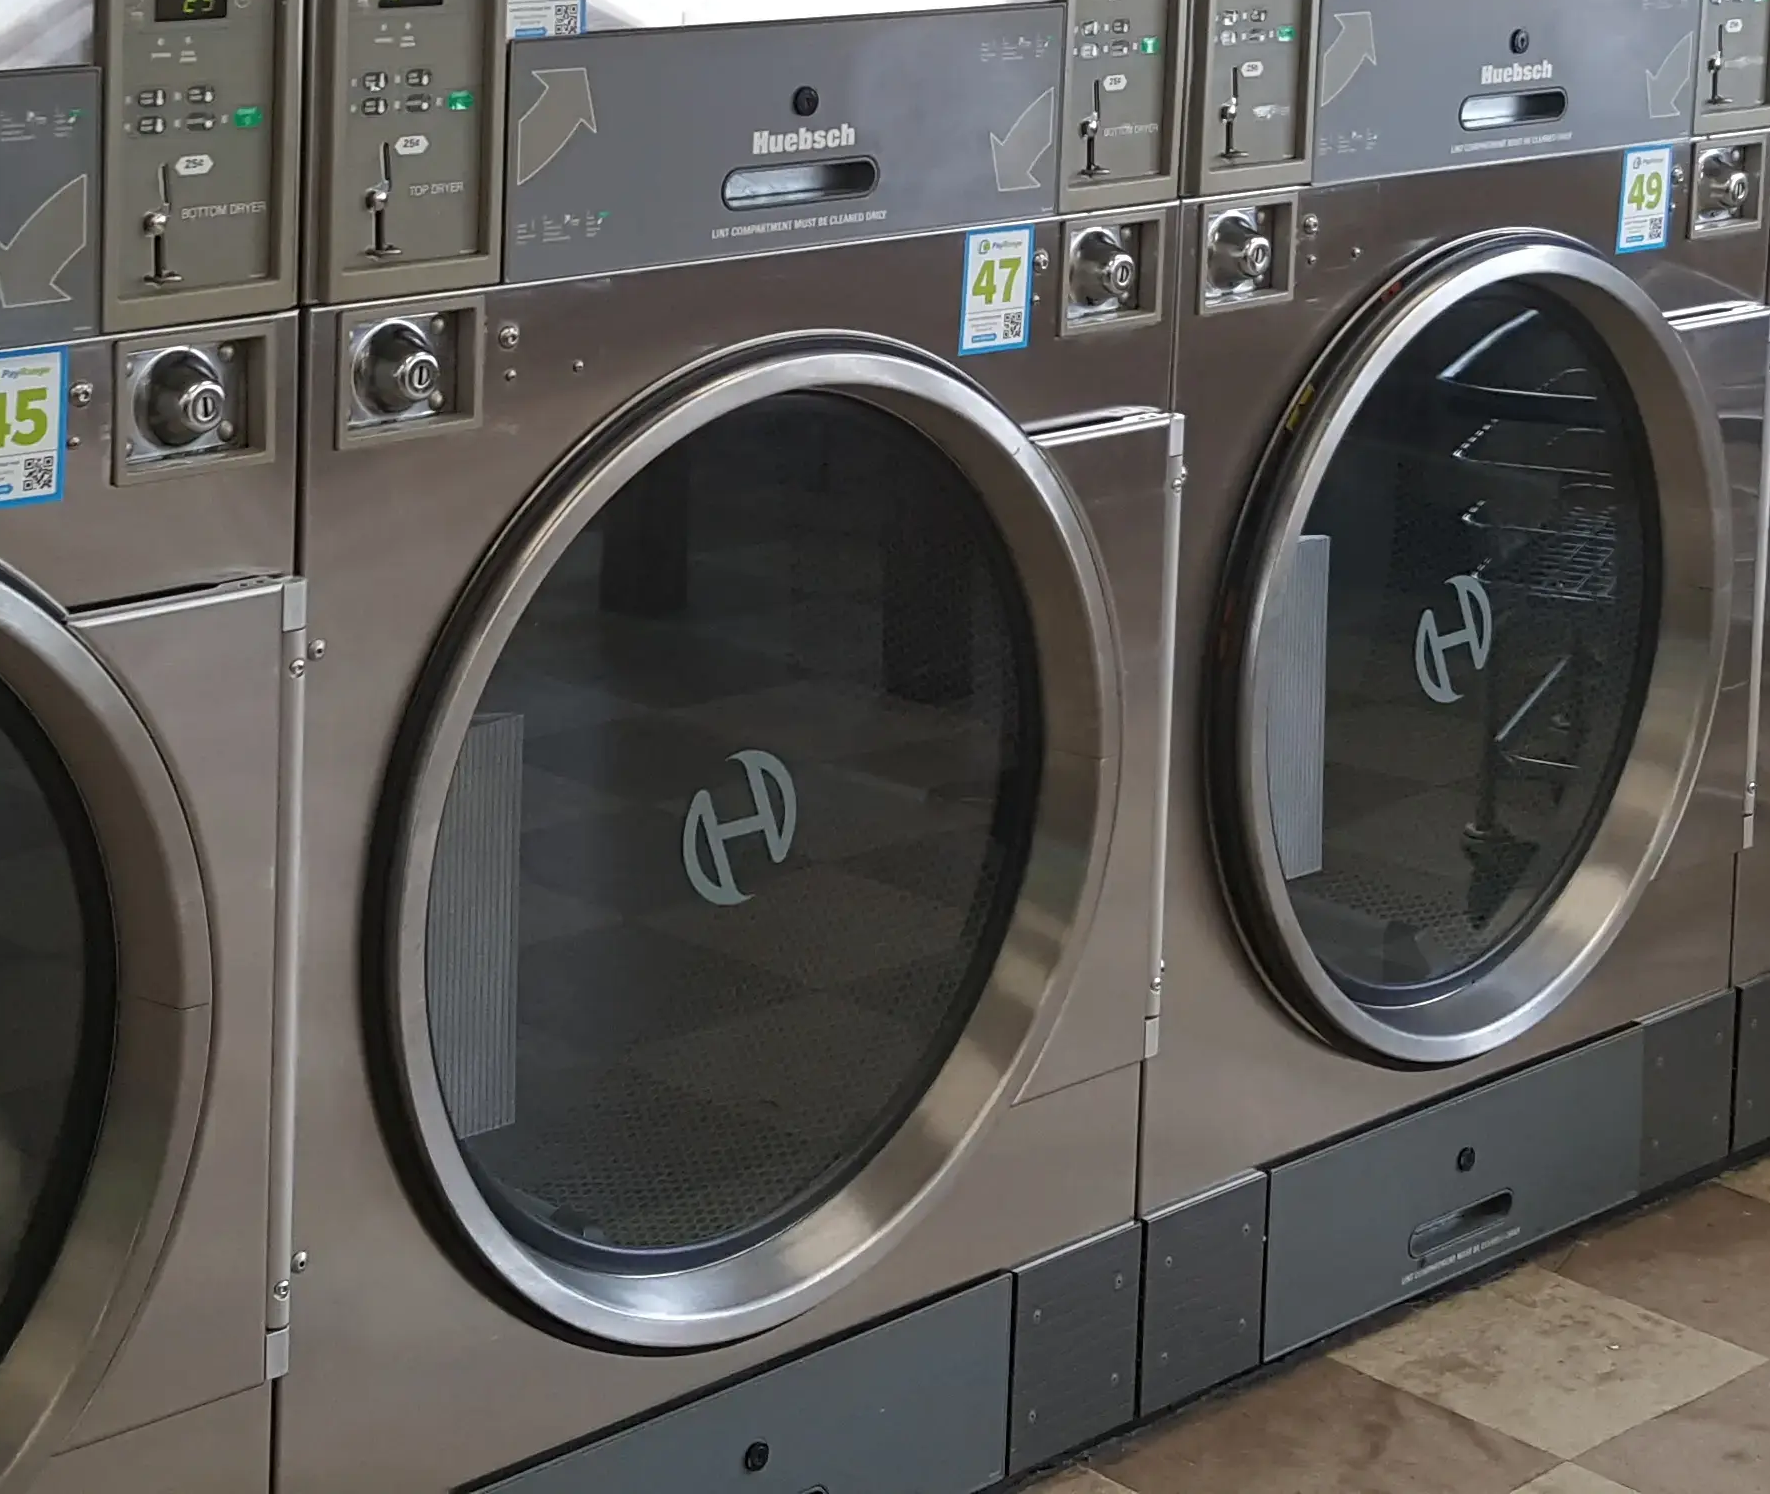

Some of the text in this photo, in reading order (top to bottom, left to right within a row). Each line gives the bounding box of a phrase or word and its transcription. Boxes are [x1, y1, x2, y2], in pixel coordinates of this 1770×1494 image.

[1481, 59, 1553, 84] Huebsch
[752, 123, 856, 155] Huebsch
[409, 181, 464, 196] TOP DRYER
[1628, 171, 1663, 211] 49
[181, 200, 267, 220] BOTTOM DRYER
[712, 228, 730, 240] LINT
[731, 219, 793, 237] COMPARTMENT
[794, 217, 816, 228] MUST
[818, 216, 828, 226] BE
[971, 256, 1022, 305] 47
